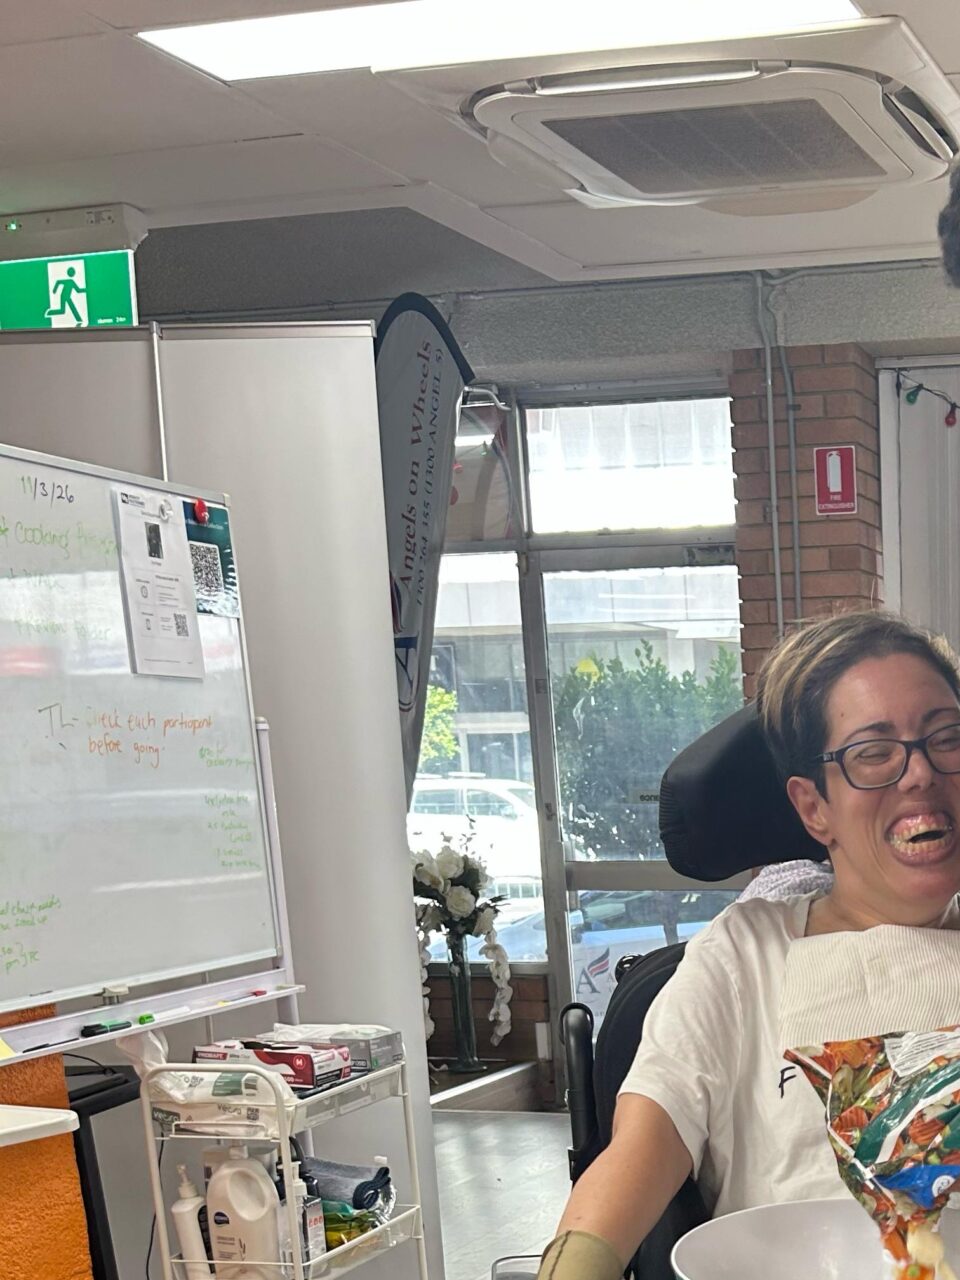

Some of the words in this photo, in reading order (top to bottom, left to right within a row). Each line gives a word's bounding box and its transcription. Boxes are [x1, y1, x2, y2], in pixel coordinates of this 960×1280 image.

[410, 340, 432, 447] Wheels
[428, 371, 442, 445] ANGEL
[408, 461, 421, 496] on
[400, 504, 417, 593] Angels
[779, 1066, 796, 1098] F
